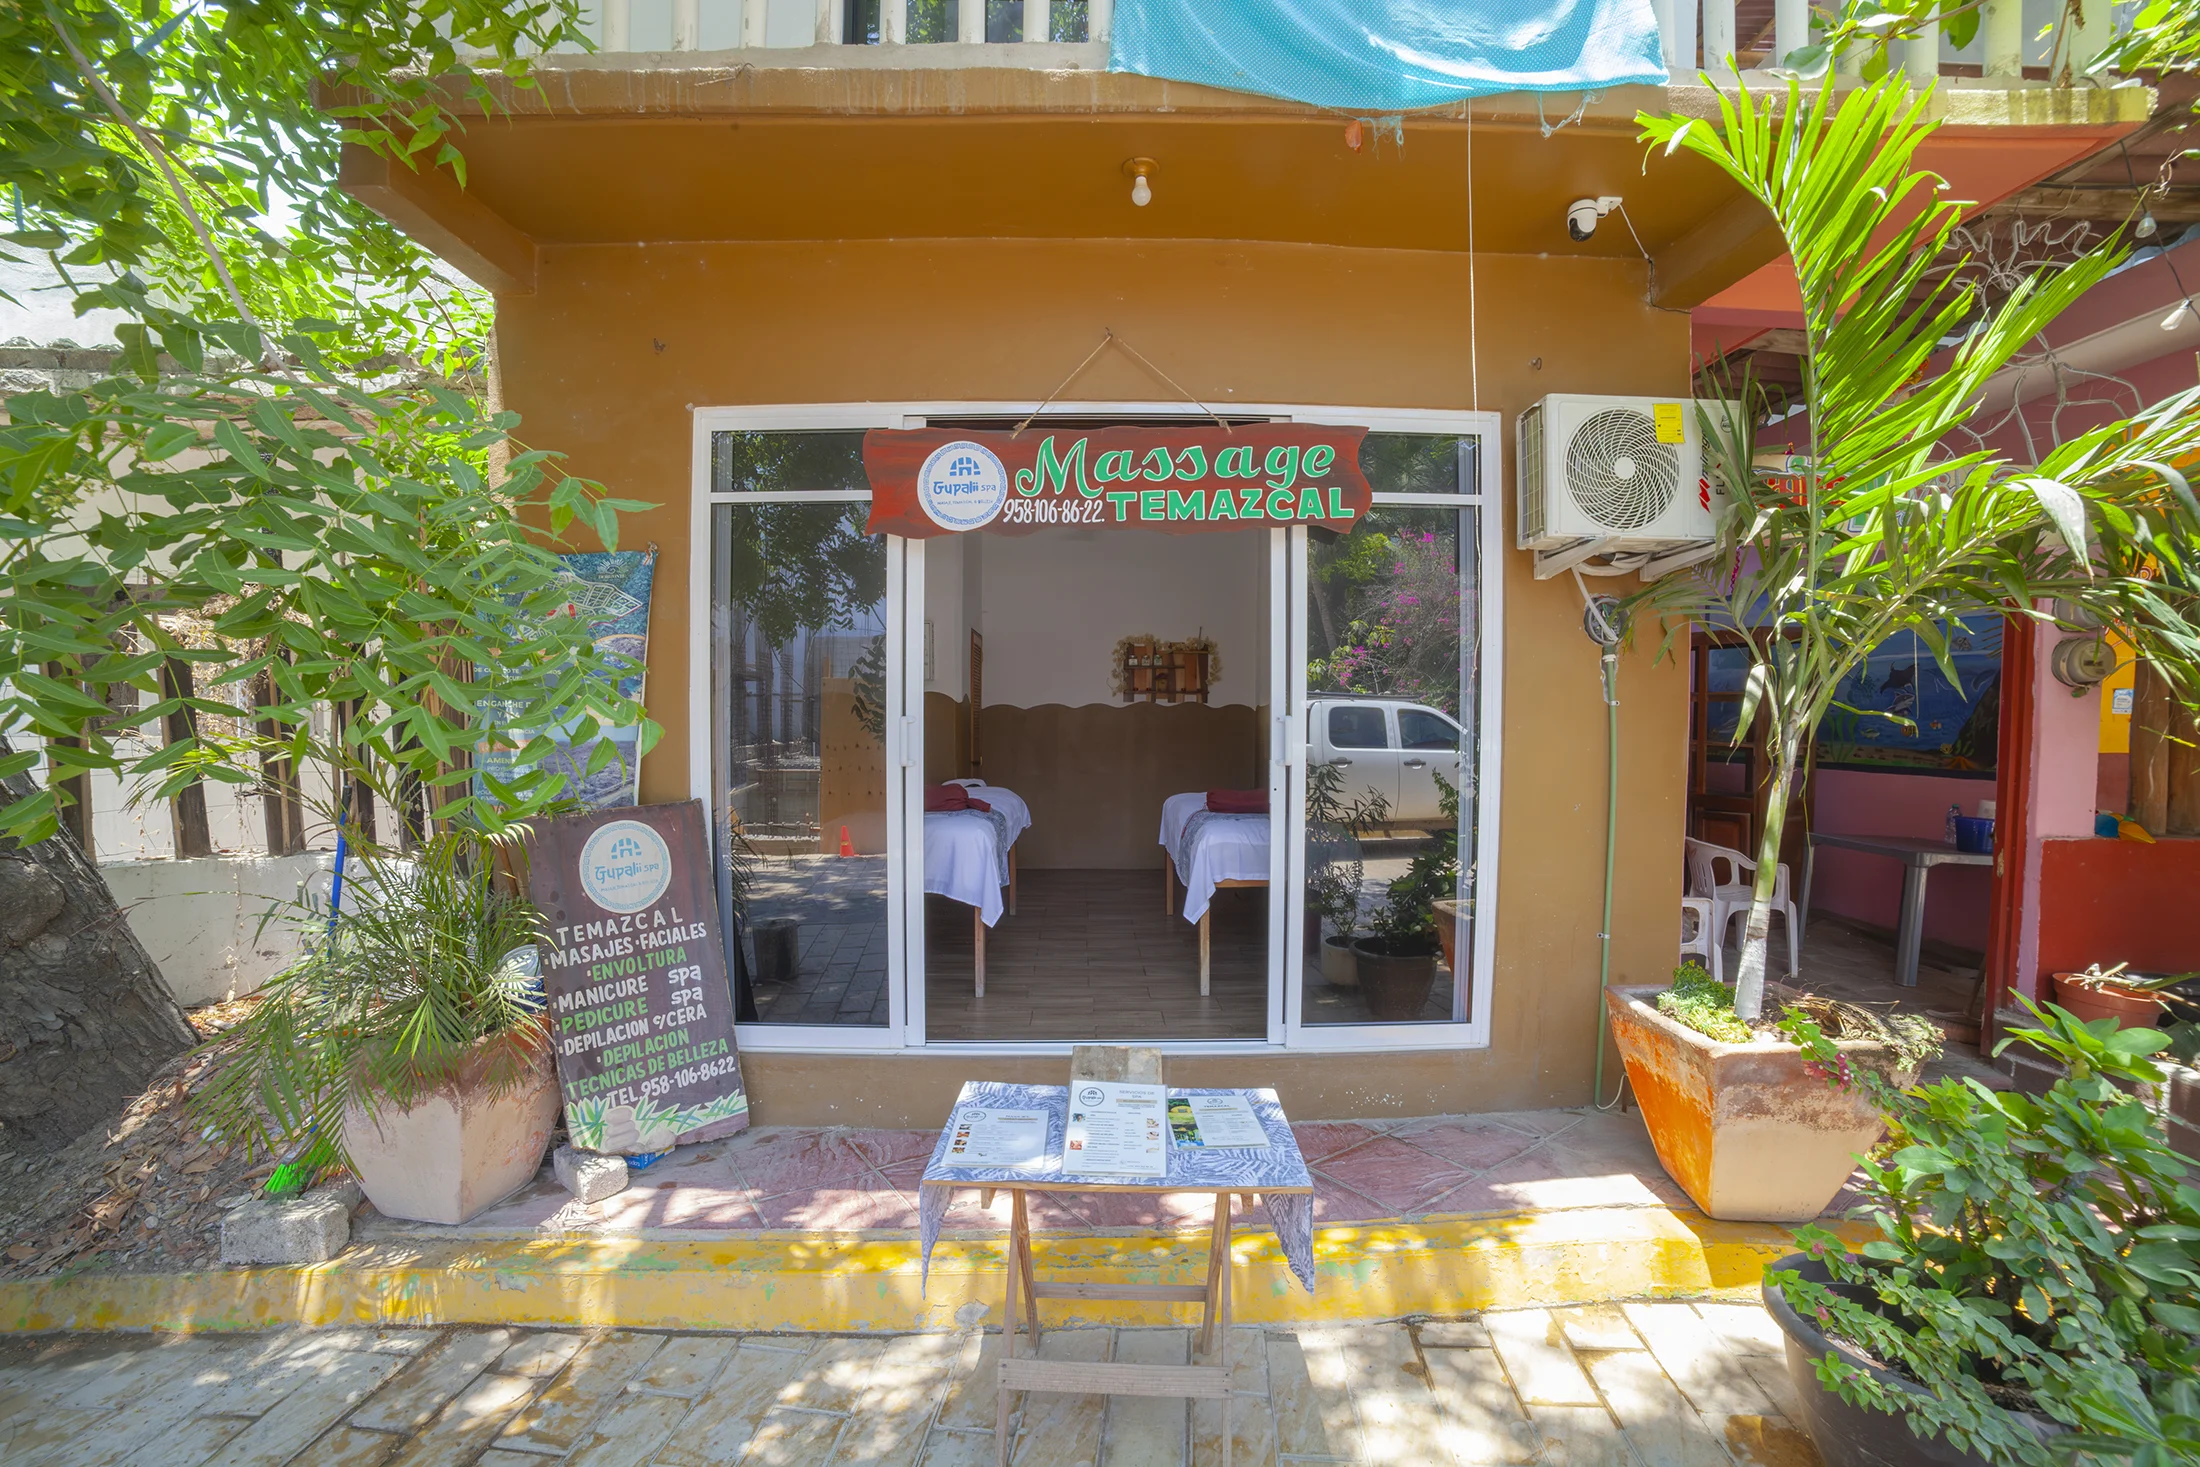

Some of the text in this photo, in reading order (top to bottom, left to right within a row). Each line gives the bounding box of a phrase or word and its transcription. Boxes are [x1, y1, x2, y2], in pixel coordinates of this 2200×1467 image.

[1015, 435, 1335, 498] Massage
[933, 480, 996, 496] Gupalii spa
[1106, 487, 1355, 521] TEMAZCAL
[595, 862, 642, 884] Gupalii
[644, 863, 659, 872] spa
[550, 922, 707, 970] MASAJES FACIALES
[556, 907, 683, 946] TEMAZCAL
[592, 946, 687, 982] ENVOLTURA
[558, 965, 701, 1013] MANICURE spa
[561, 986, 703, 1035] PEDICURE spa
[564, 1018, 649, 1056] DEPILACION
[603, 1028, 690, 1067] DEPILACION
[566, 1038, 729, 1100] TECNICAS DE BELLEZA
